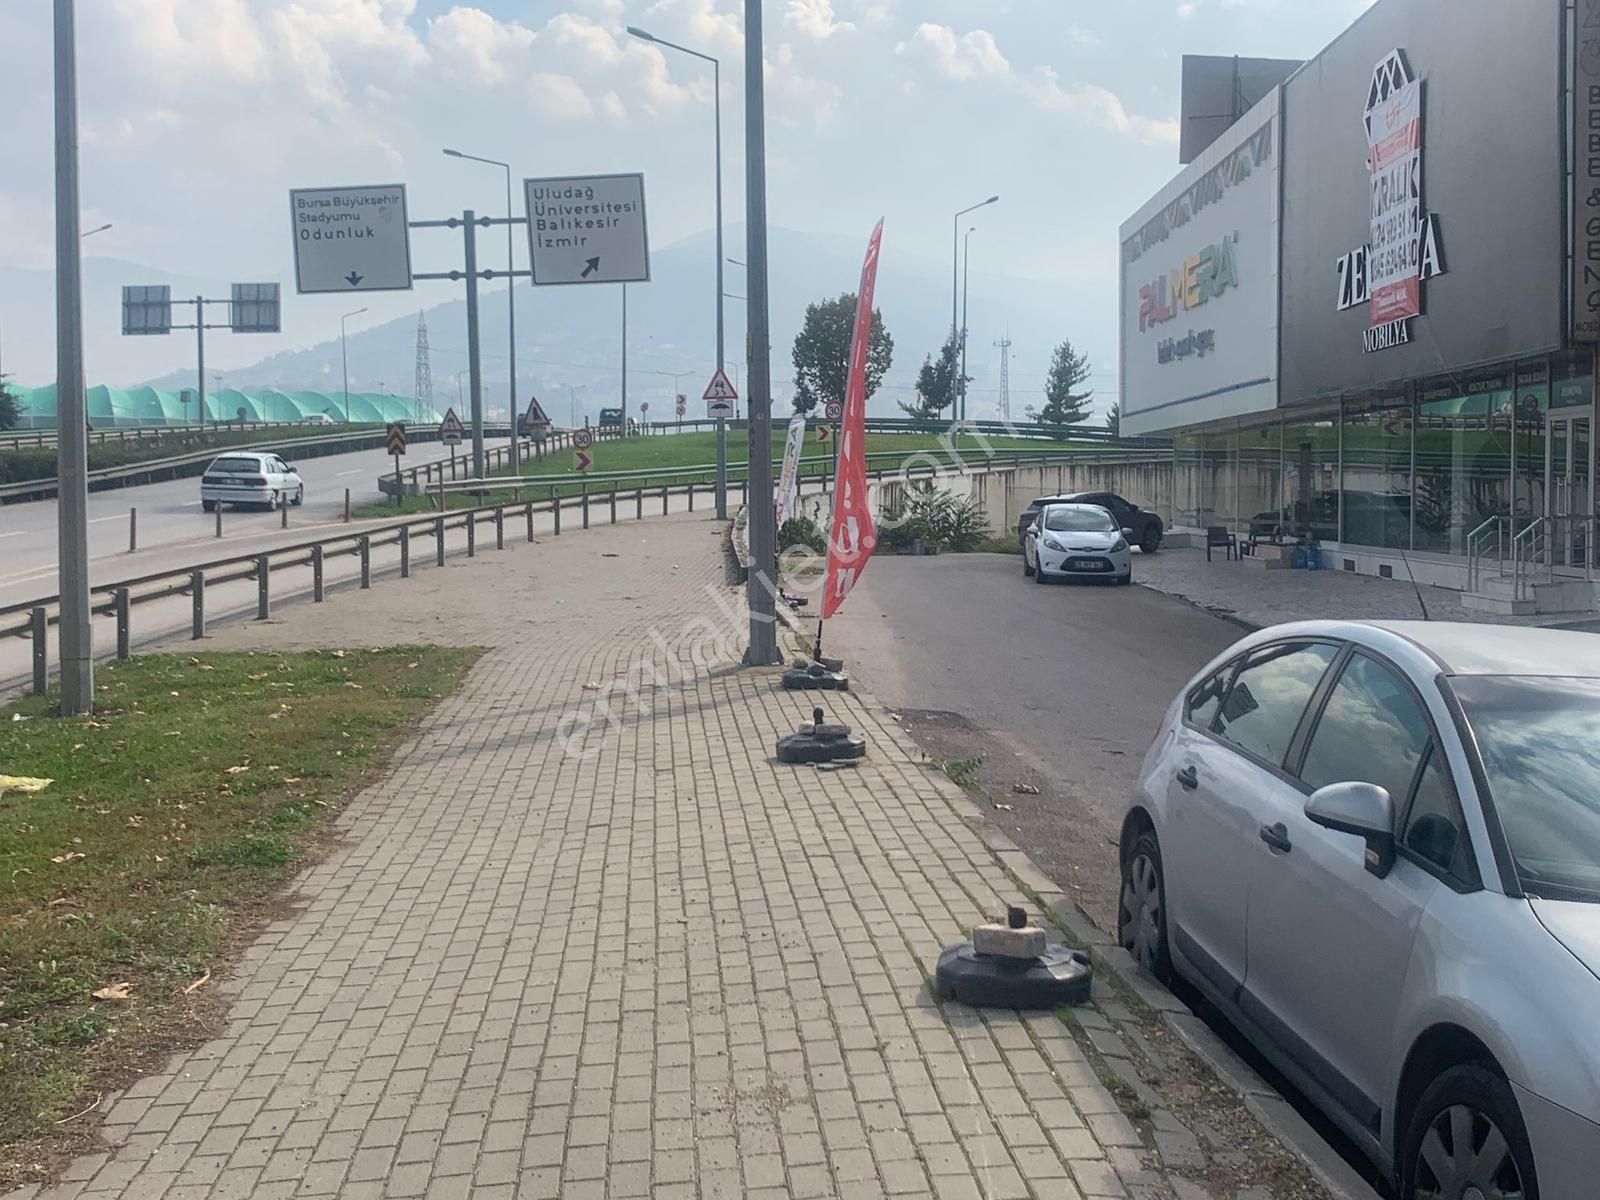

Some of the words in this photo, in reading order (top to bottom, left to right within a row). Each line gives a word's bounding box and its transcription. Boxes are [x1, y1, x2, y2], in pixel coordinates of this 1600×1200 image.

[534, 186, 594, 200] Uludağ
[298, 198, 332, 209] Bursa
[333, 194, 400, 209] Büyükşehir
[535, 200, 637, 217] Üniversitesi
[299, 211, 361, 224] Stadyumu
[536, 216, 620, 231] Balıkesir
[300, 226, 375, 241] Odunluk
[537, 232, 587, 248] İzmir
[829, 406, 839, 416] 30
[575, 434, 588, 444] 30
